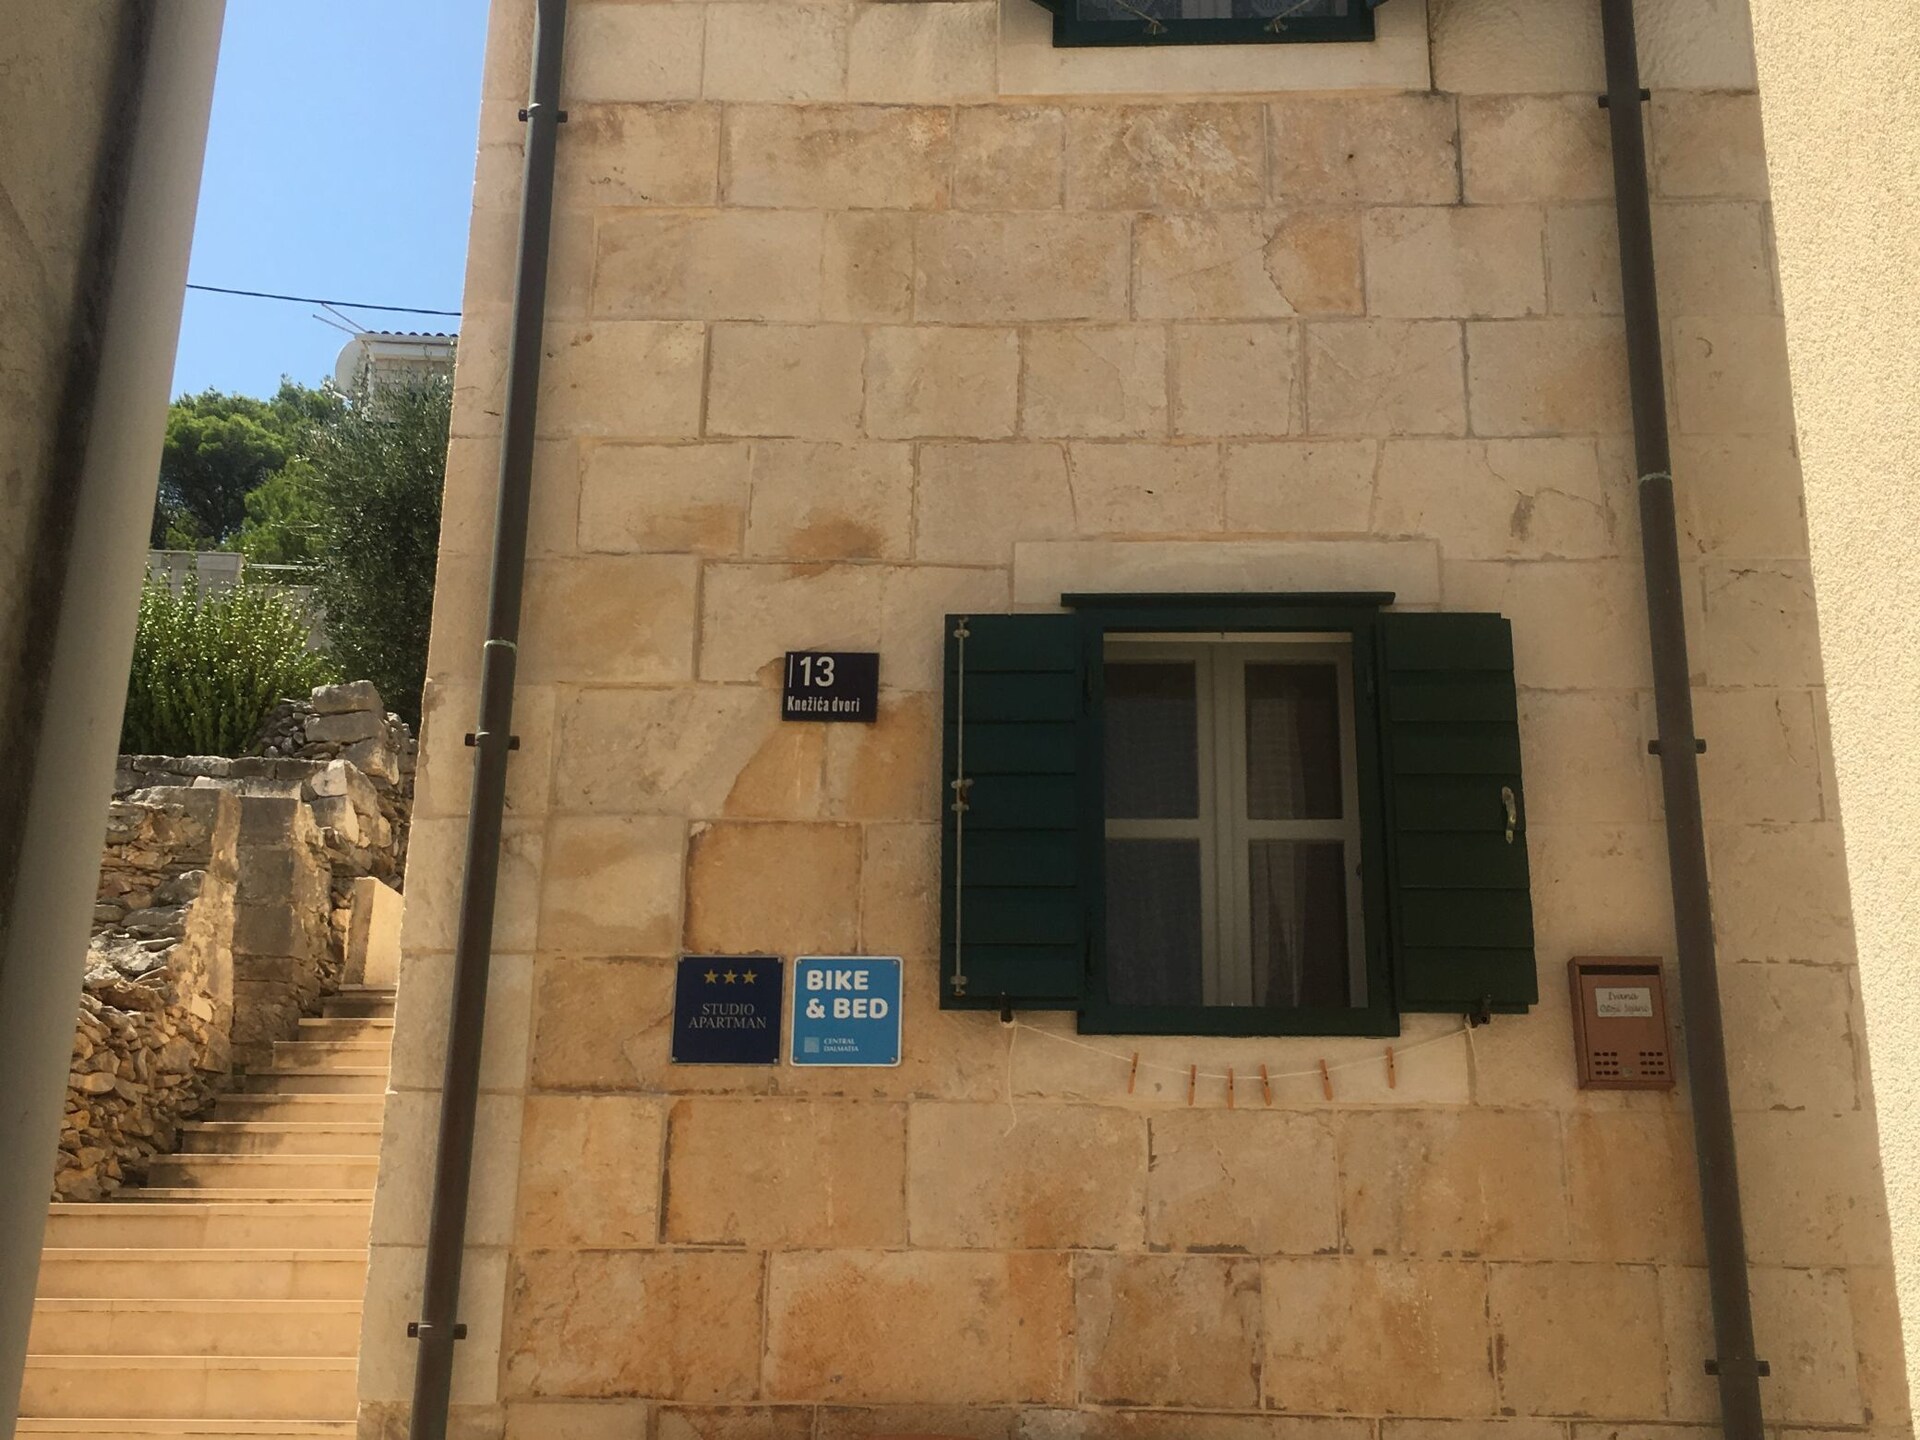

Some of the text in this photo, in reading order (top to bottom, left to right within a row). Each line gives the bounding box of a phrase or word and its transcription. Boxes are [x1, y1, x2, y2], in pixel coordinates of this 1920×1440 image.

[800, 656, 835, 687] 13
[787, 696, 860, 713] Knežića dvori
[806, 969, 870, 991] BIKE
[702, 1003, 755, 1016] STUDIO
[806, 998, 889, 1019] & BED
[688, 1016, 767, 1029] APARTMAN
[823, 1037, 855, 1045] CENTRAL
[823, 1045, 860, 1053] DALMATIA
